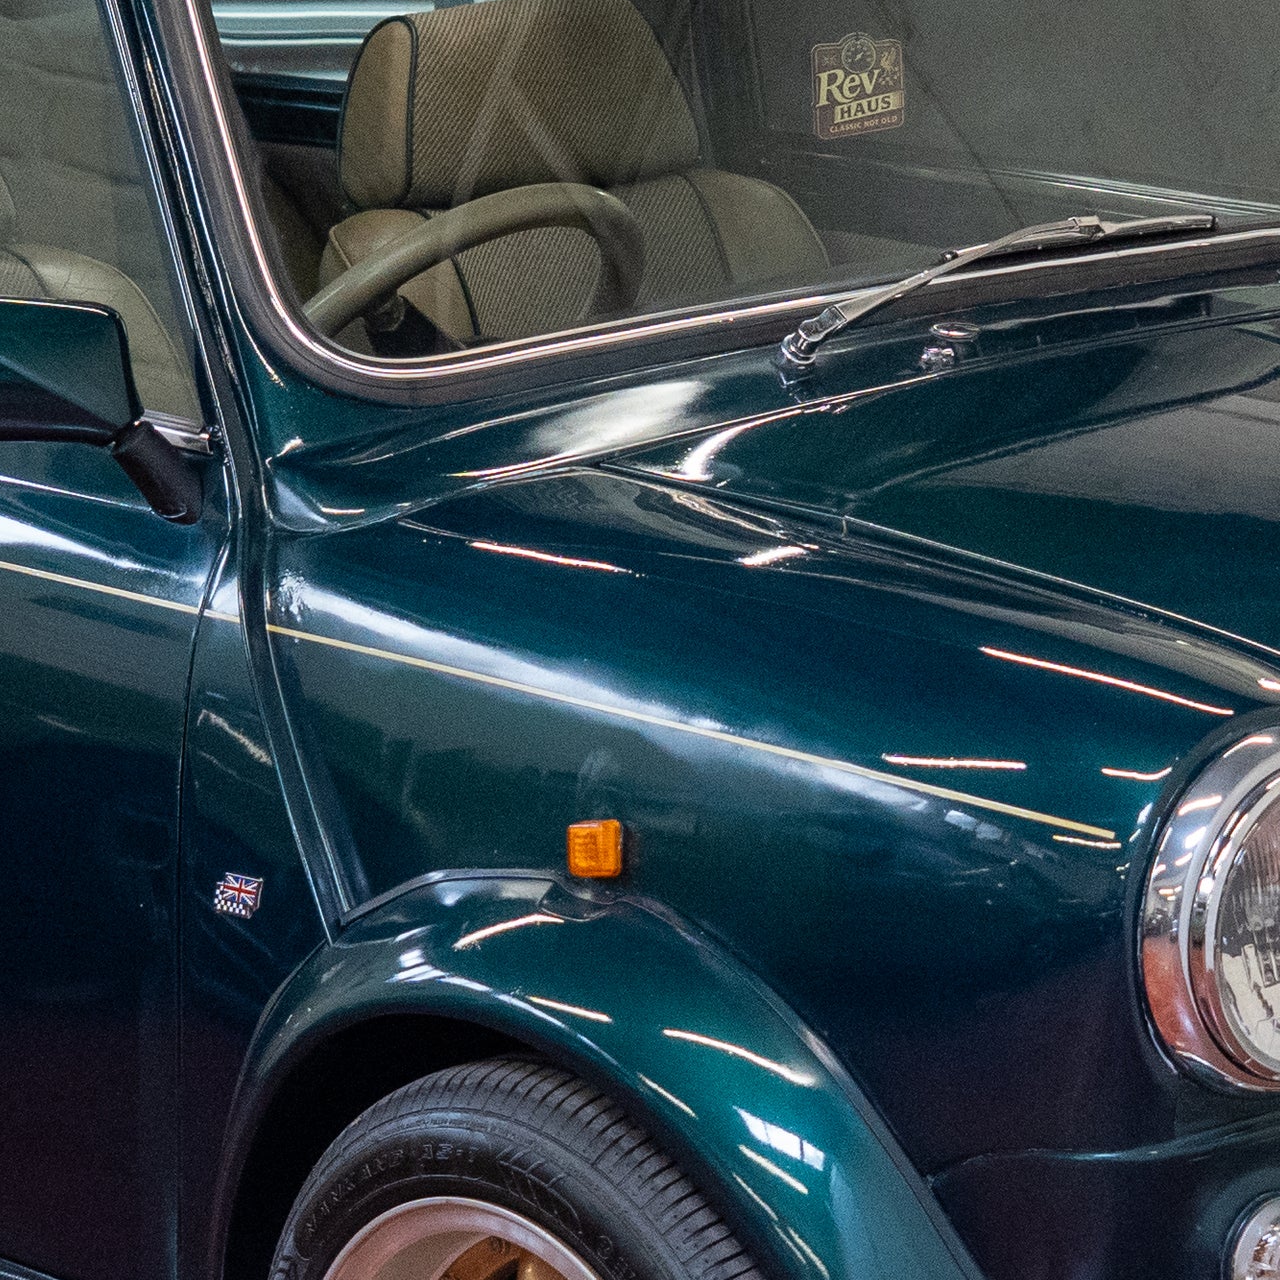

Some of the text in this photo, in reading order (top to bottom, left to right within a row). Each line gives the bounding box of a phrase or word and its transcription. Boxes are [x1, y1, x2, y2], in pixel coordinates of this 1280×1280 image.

[816, 69, 881, 108] Rev
[840, 95, 891, 120] HAUS
[829, 115, 898, 133] CLASSIC NOT OLD
